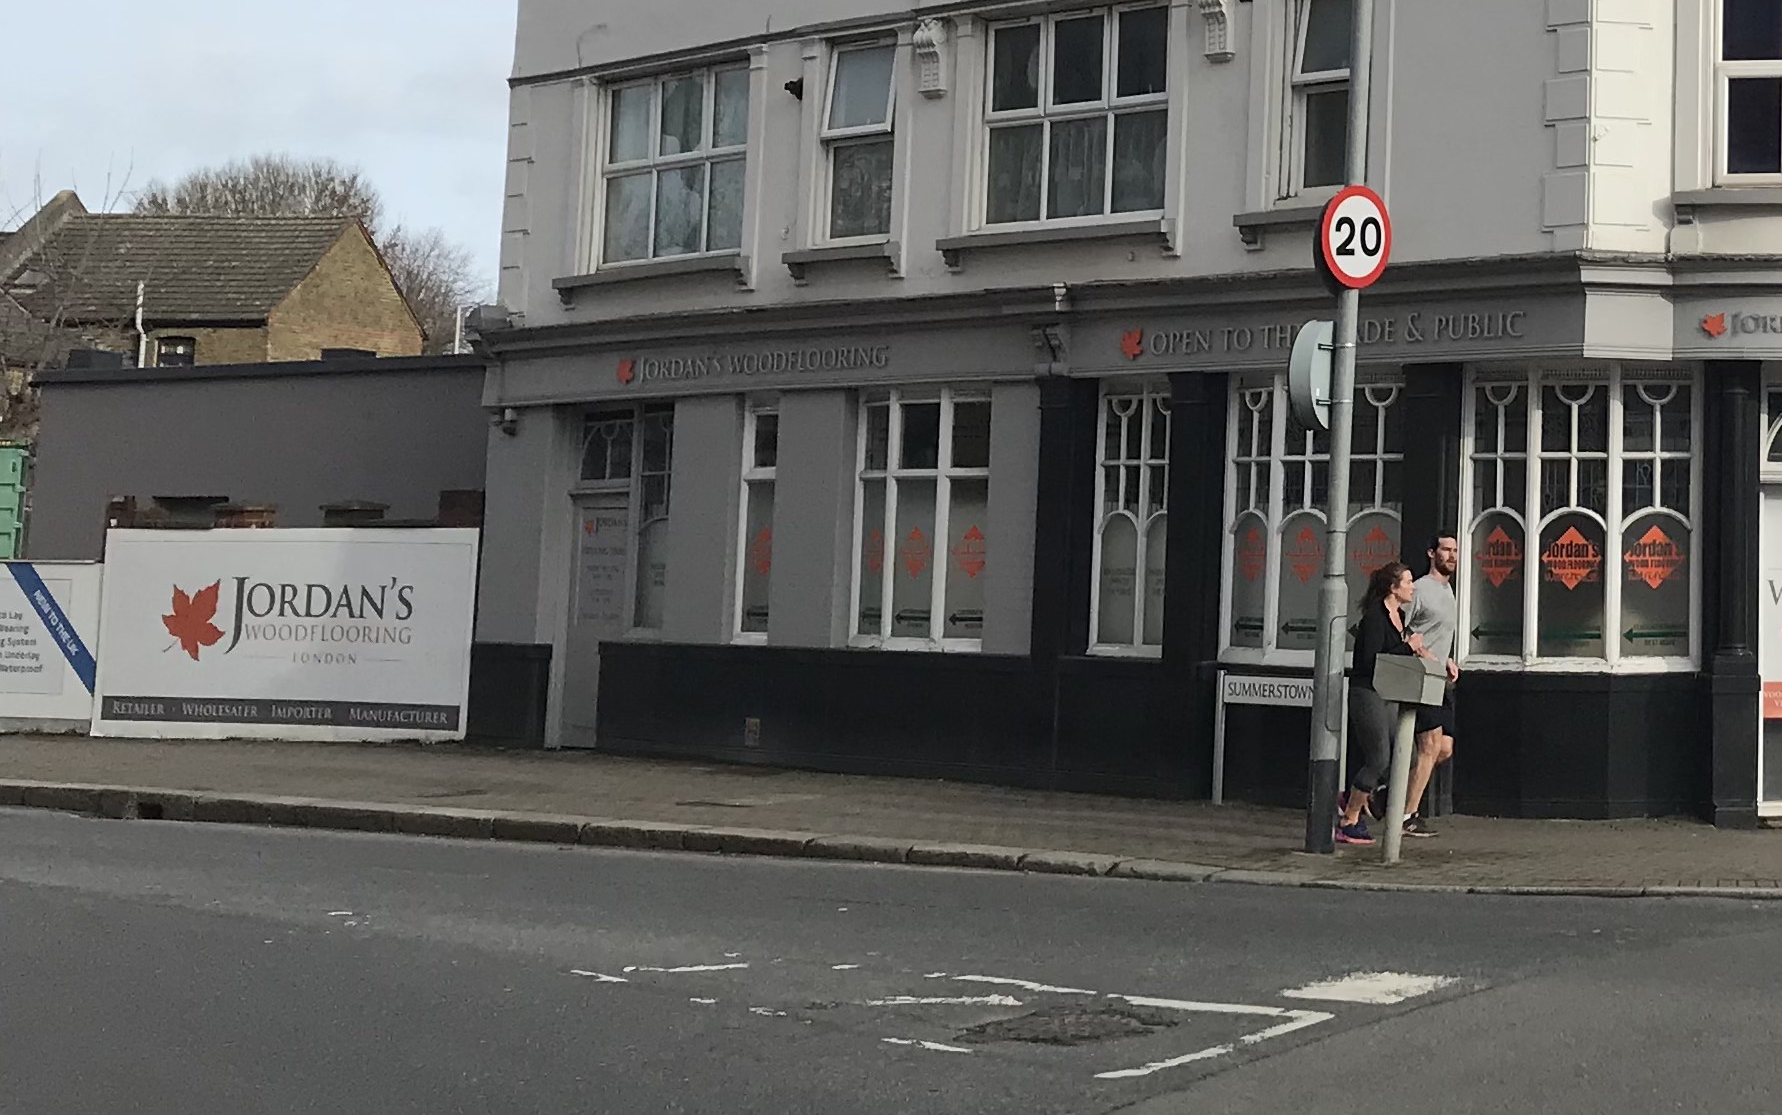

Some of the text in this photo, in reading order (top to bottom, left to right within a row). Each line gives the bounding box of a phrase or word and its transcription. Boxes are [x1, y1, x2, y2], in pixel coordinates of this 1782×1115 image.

[1335, 217, 1382, 257] 20
[1151, 329, 1211, 356] OPEN
[1222, 327, 1252, 351] TO
[1261, 323, 1300, 349] TH
[1405, 312, 1424, 341] &
[1434, 311, 1526, 340] PUBLIC
[639, 345, 889, 383] JORDAN'S WOODFLOORING
[223, 576, 414, 654] JORDAN'S
[245, 623, 412, 645] WOODFLOORING
[292, 652, 357, 665] LONDON
[112, 700, 448, 724] RETAILER WHOLESALER IMPORTER MANUFACTURER
